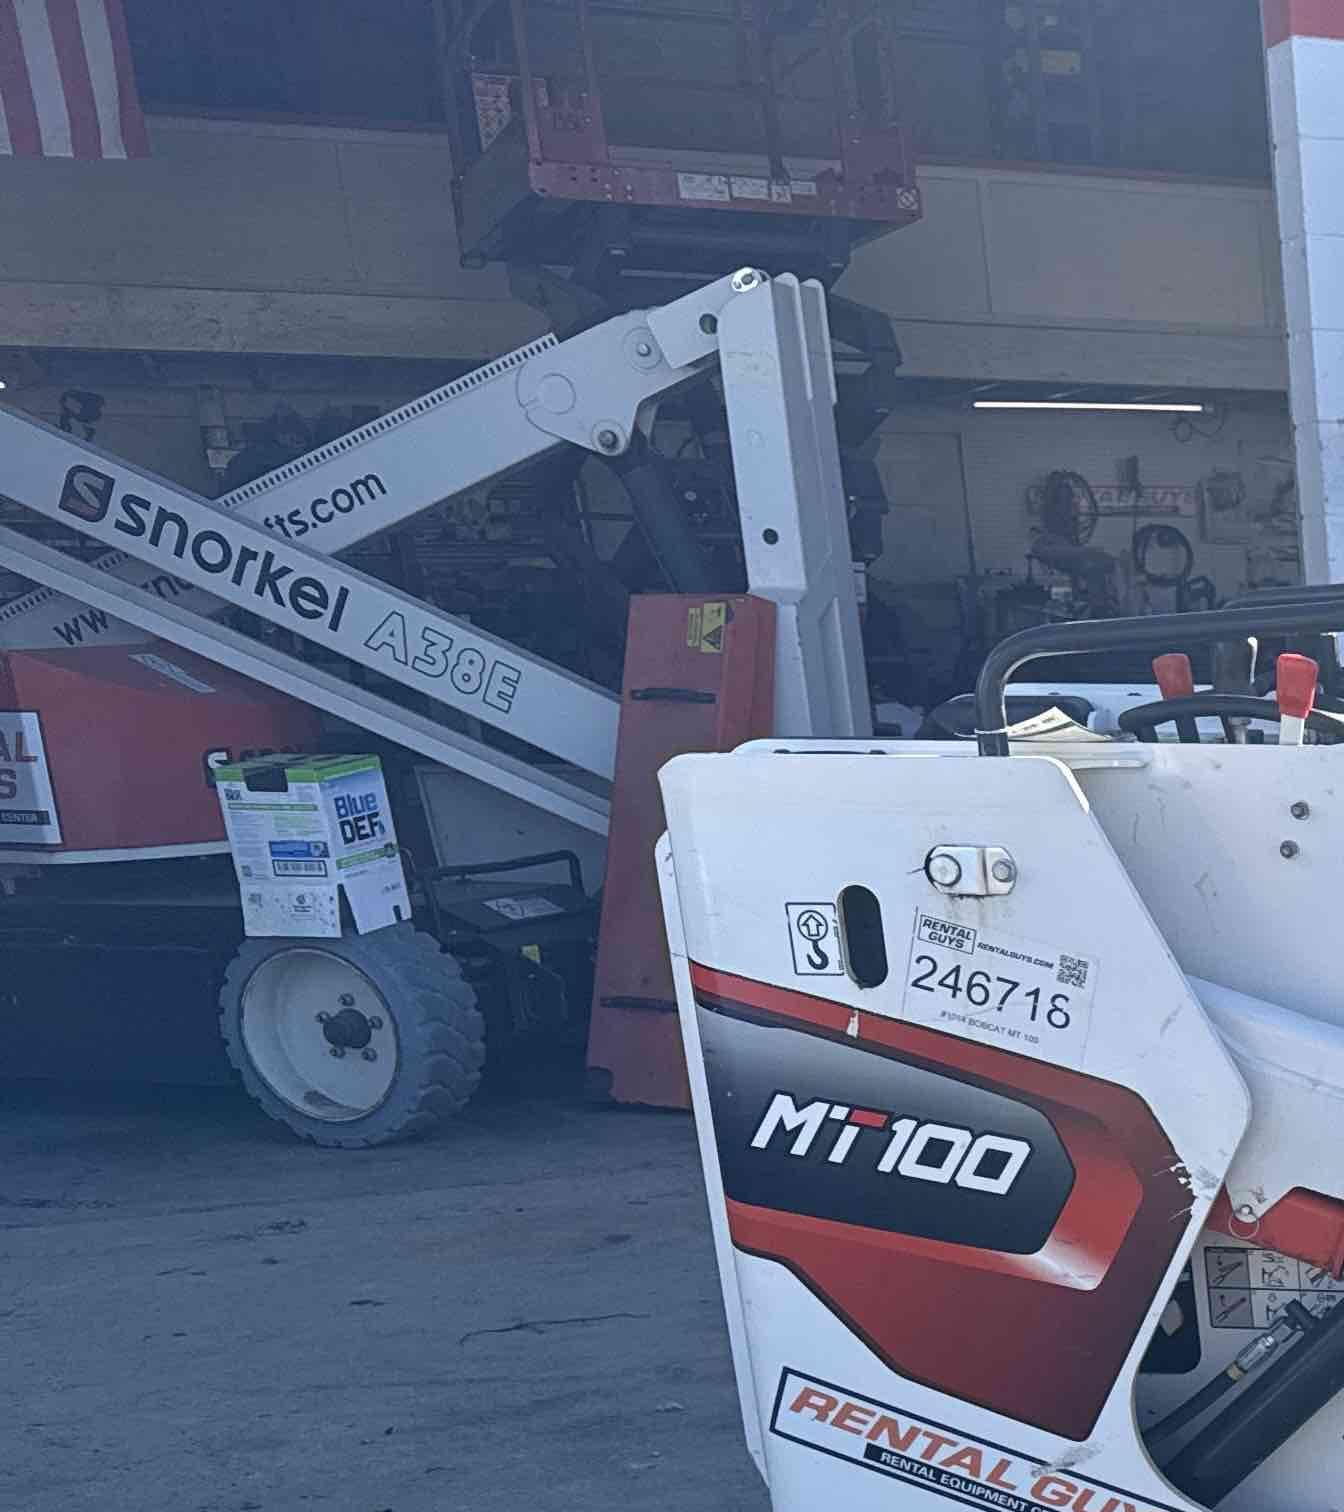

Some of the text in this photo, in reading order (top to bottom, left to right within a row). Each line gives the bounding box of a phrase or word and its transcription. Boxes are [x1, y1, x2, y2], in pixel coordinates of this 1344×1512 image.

[114, 493, 350, 633] snorkel
[363, 610, 522, 714] A38E
[333, 792, 379, 819] Blue
[922, 918, 972, 941] RENTAL
[928, 931, 965, 949] GUYS
[977, 941, 1054, 969] RENTALGUYS.COM
[789, 1386, 1020, 1492] RENTAL
[879, 1451, 938, 1481] RENTAL
[940, 1474, 1029, 1512] EQUIPMENT
